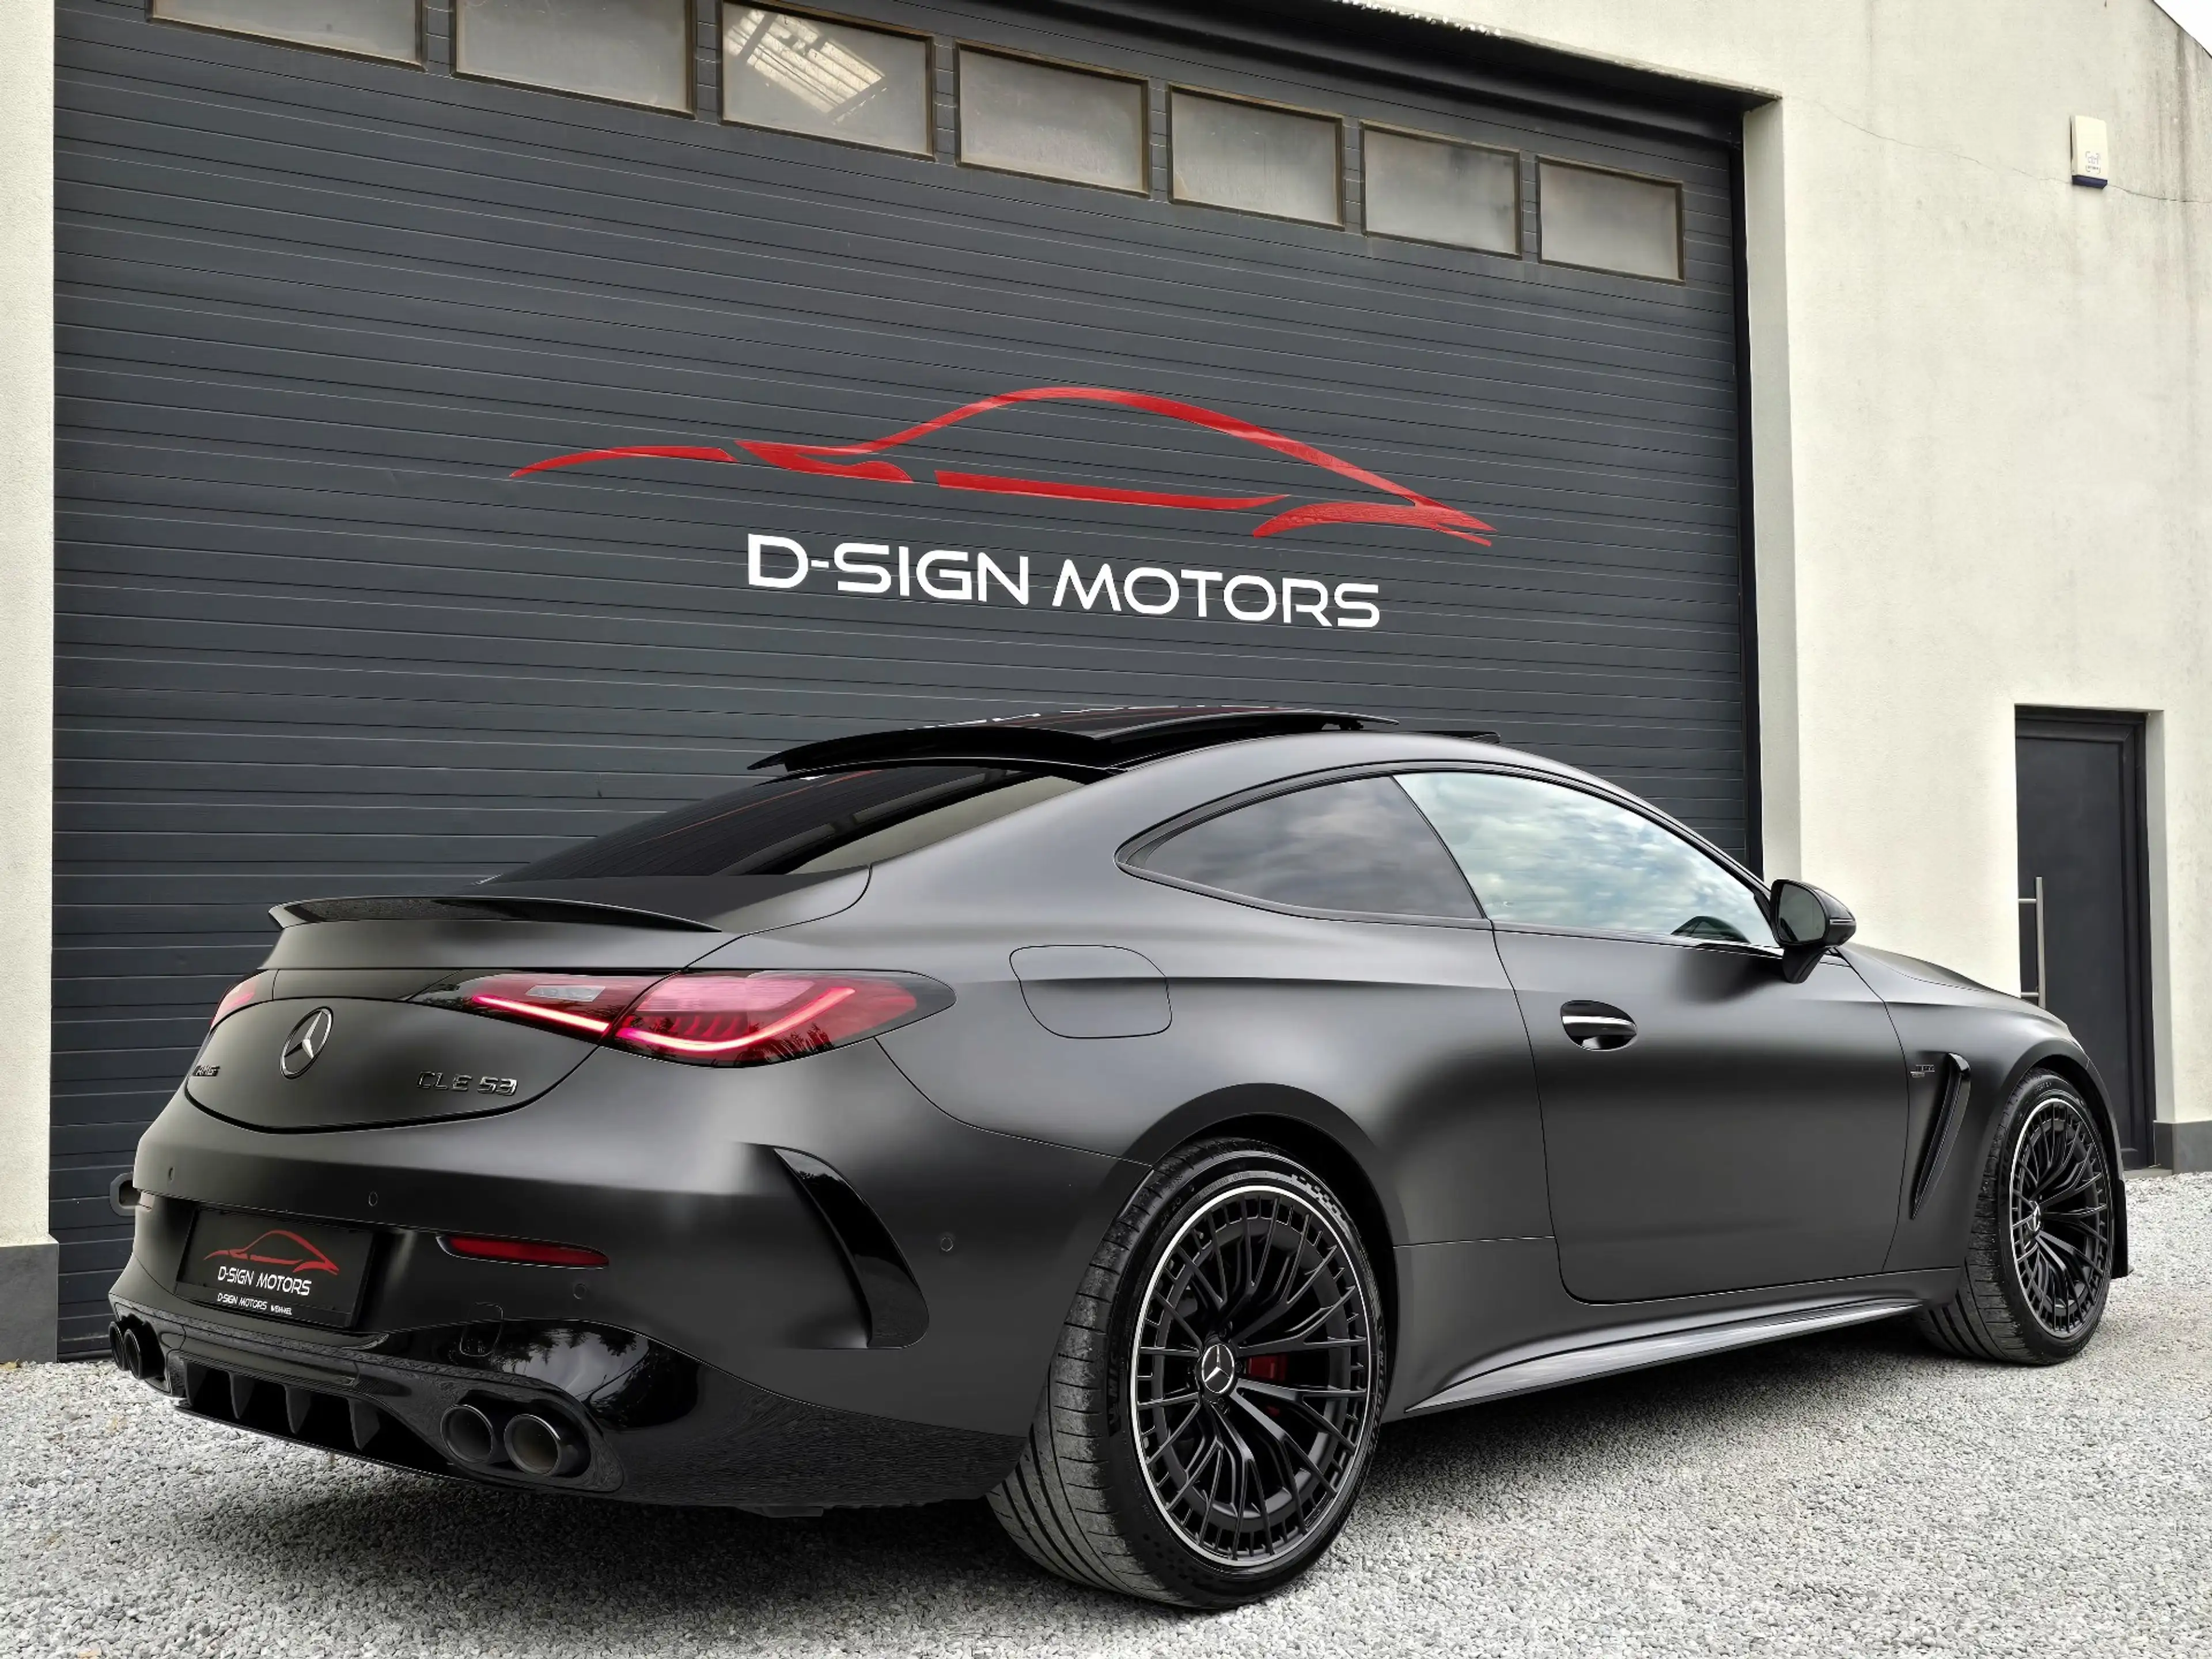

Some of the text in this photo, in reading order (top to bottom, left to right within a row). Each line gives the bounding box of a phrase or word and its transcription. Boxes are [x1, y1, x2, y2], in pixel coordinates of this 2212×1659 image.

[747, 533, 1380, 628] D-SIGN MOTORS
[417, 1071, 517, 1096] CLE 53
[218, 1266, 312, 1296] D-SIGN MOTORS
[238, 1296, 268, 1310] MOTORS
